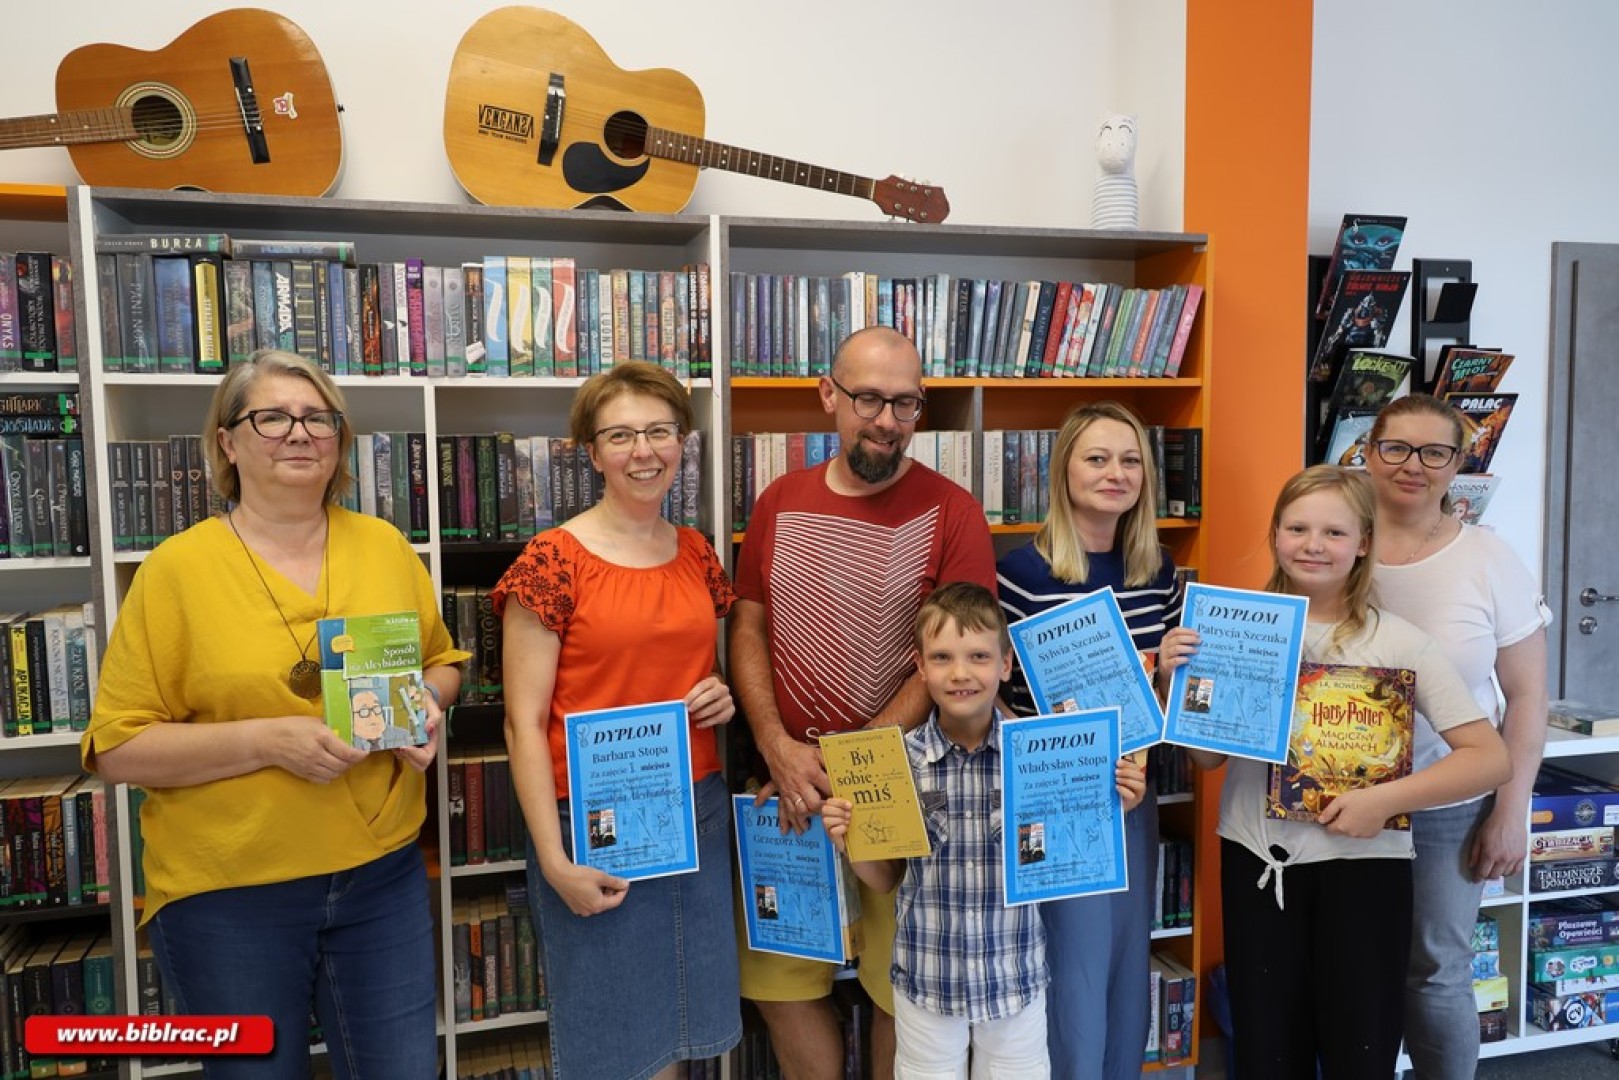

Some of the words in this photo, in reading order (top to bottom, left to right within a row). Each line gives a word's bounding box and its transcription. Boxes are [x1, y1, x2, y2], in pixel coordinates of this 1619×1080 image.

[150, 238, 202, 249] BURZA
[275, 272, 292, 333] ARMADA
[1, 313, 14, 349] ONYKS
[1208, 605, 1279, 625] DYPLOM
[1037, 612, 1097, 645] DYPLOM
[1197, 623, 1240, 640] Patrycja
[1243, 628, 1288, 645] Szczuka
[383, 644, 415, 657] Sposób
[15, 668, 28, 720] APLIKACJA
[1312, 701, 1346, 727] Harry
[1346, 701, 1384, 727] Potter
[593, 723, 662, 746] DYPLOM
[1027, 732, 1095, 753] DYPLOM
[1321, 729, 1375, 741] MAGICZNY
[592, 750, 636, 764] Barbara
[638, 745, 668, 758] Stopa
[1316, 739, 1377, 752] ALMANACH
[850, 748, 875, 767] Był
[1017, 759, 1075, 776] Władysław
[1078, 754, 1108, 768] Stopa
[836, 772, 873, 787] sobie
[854, 783, 892, 805] miś
[1559, 927, 1603, 940] Opowieści
